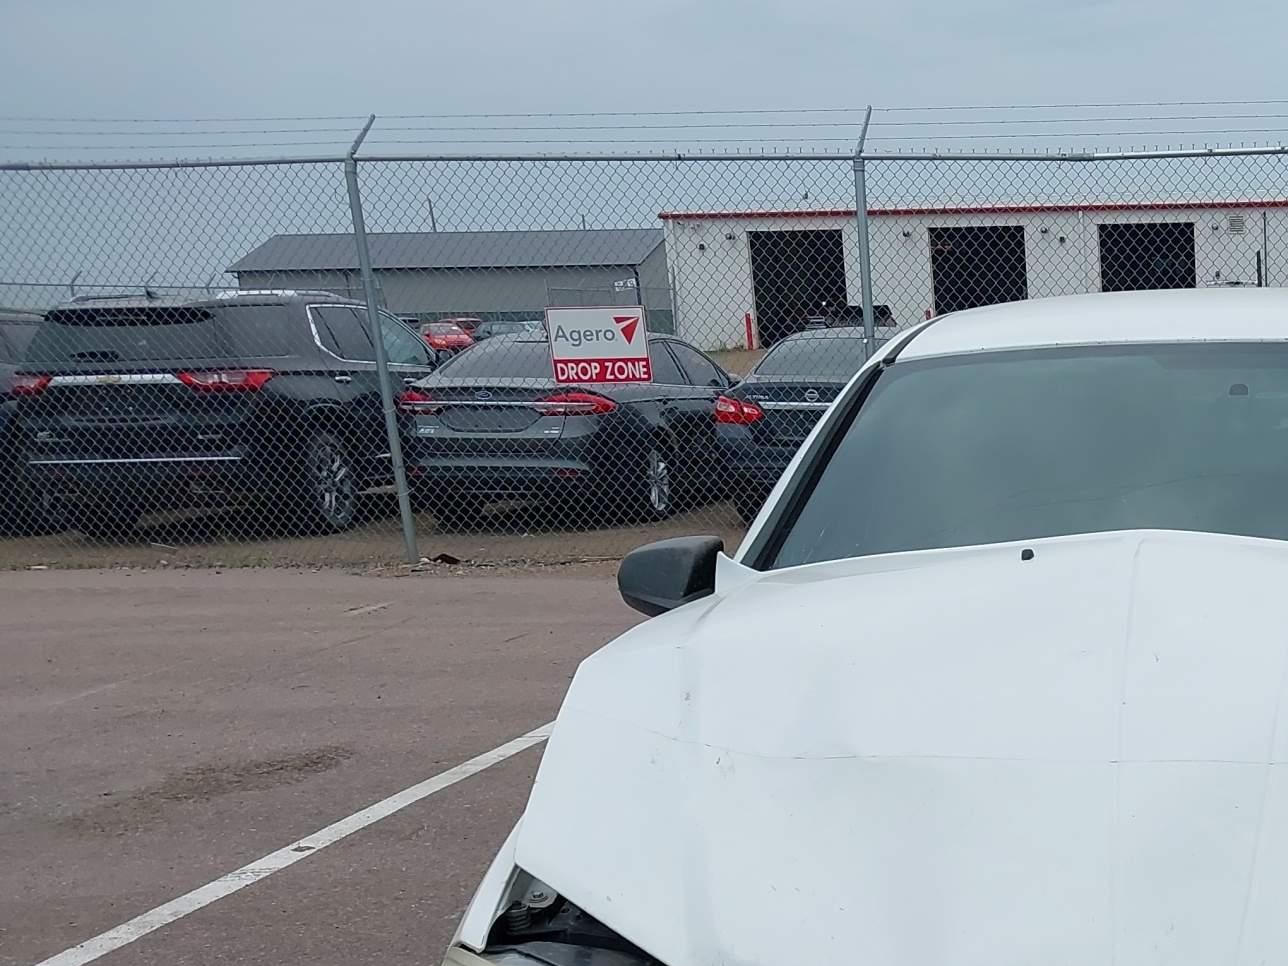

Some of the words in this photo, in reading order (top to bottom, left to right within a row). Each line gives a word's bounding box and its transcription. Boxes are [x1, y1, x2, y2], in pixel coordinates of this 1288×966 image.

[554, 325, 616, 347] Agero
[557, 362, 600, 380] DROP
[605, 361, 649, 379] ZONE
